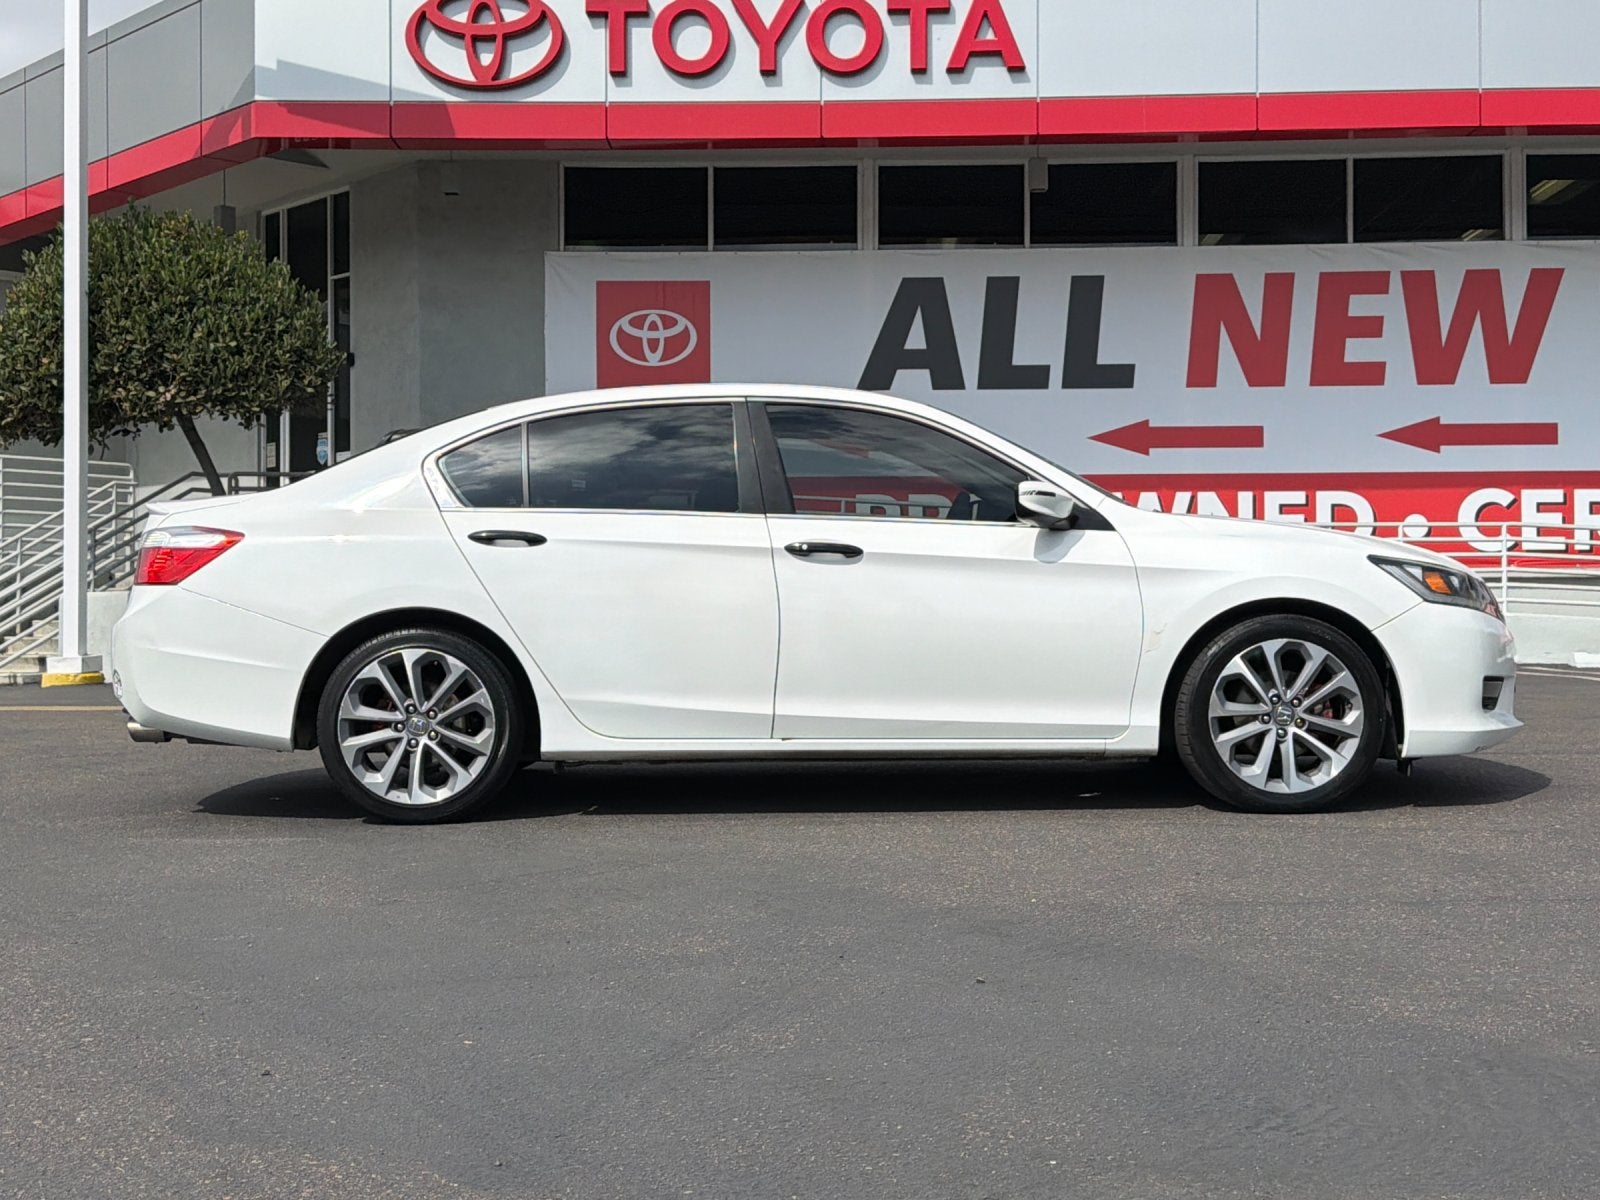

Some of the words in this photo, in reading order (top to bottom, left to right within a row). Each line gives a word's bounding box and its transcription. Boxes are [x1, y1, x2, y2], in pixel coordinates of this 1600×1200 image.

[585, 0, 1026, 76] TOYOTA
[856, 275, 1136, 390] ALL
[1186, 268, 1565, 388] NEW
